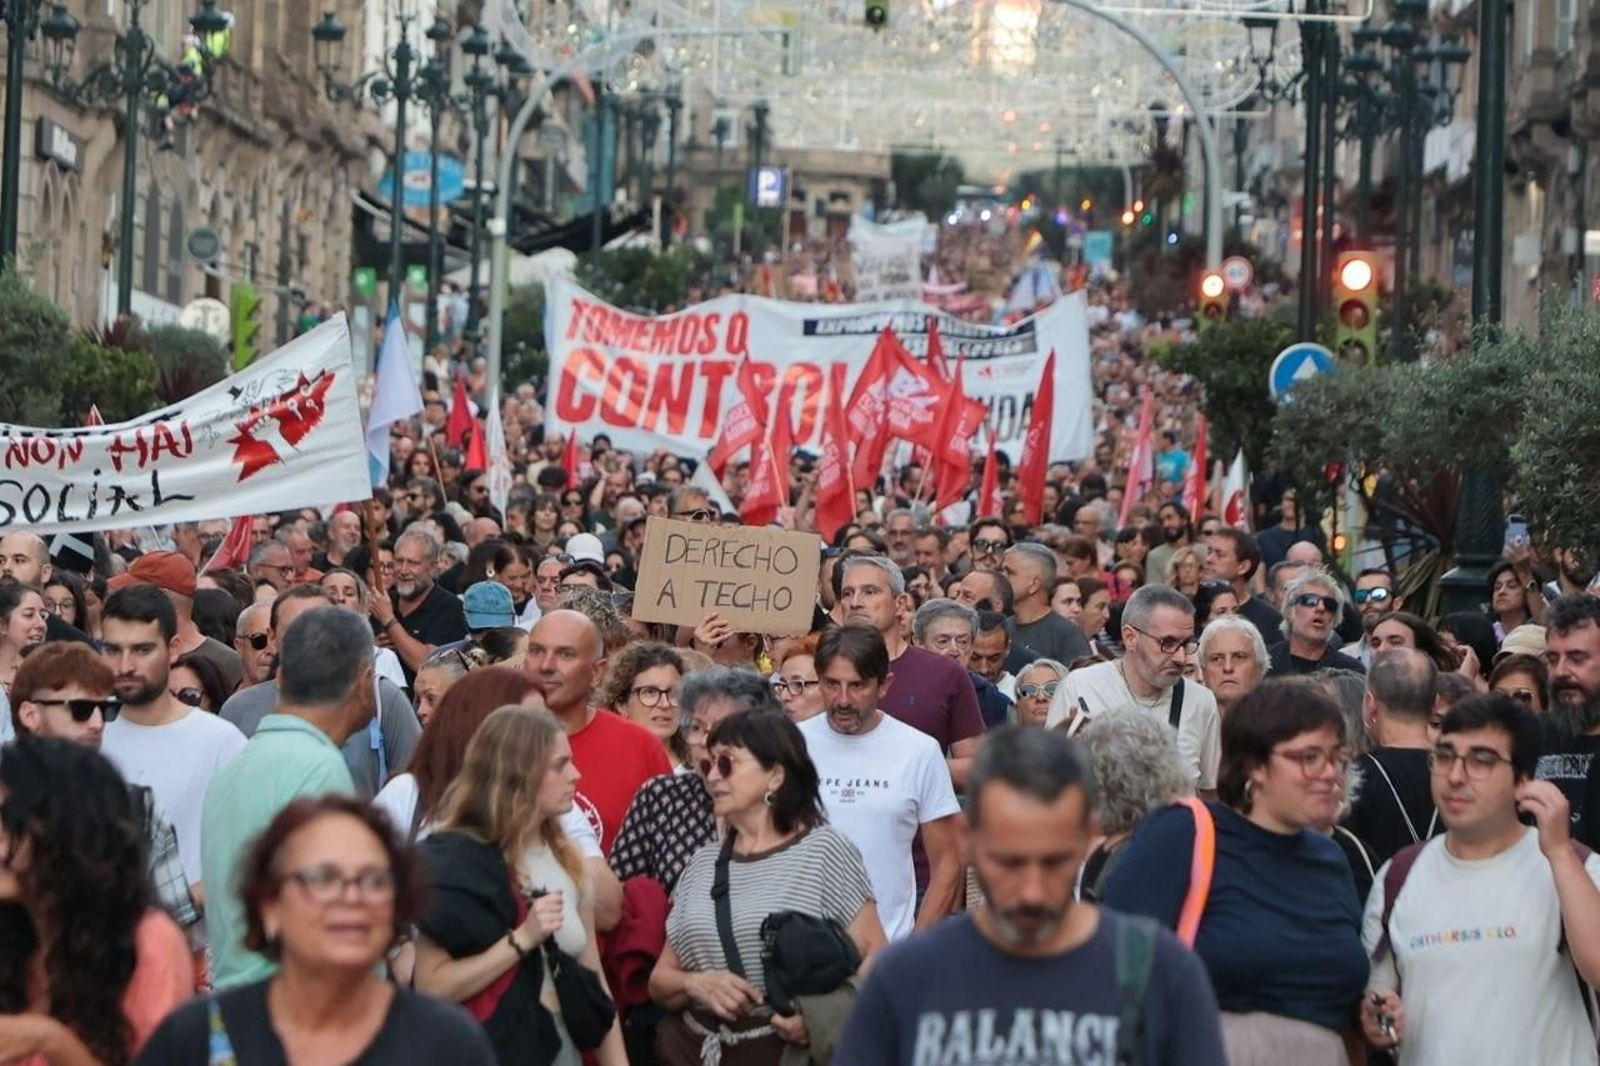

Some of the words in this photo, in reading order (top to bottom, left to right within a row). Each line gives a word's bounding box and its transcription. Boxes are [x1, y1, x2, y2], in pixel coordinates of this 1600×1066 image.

[564, 297, 721, 356] TOMEMOS
[725, 310, 749, 354] O
[5, 437, 84, 471] NON
[107, 419, 193, 472] HAI
[665, 533, 798, 575] DERECHO
[656, 578, 677, 609] A
[694, 580, 793, 613] TECHO
[846, 779, 889, 789] JEANS
